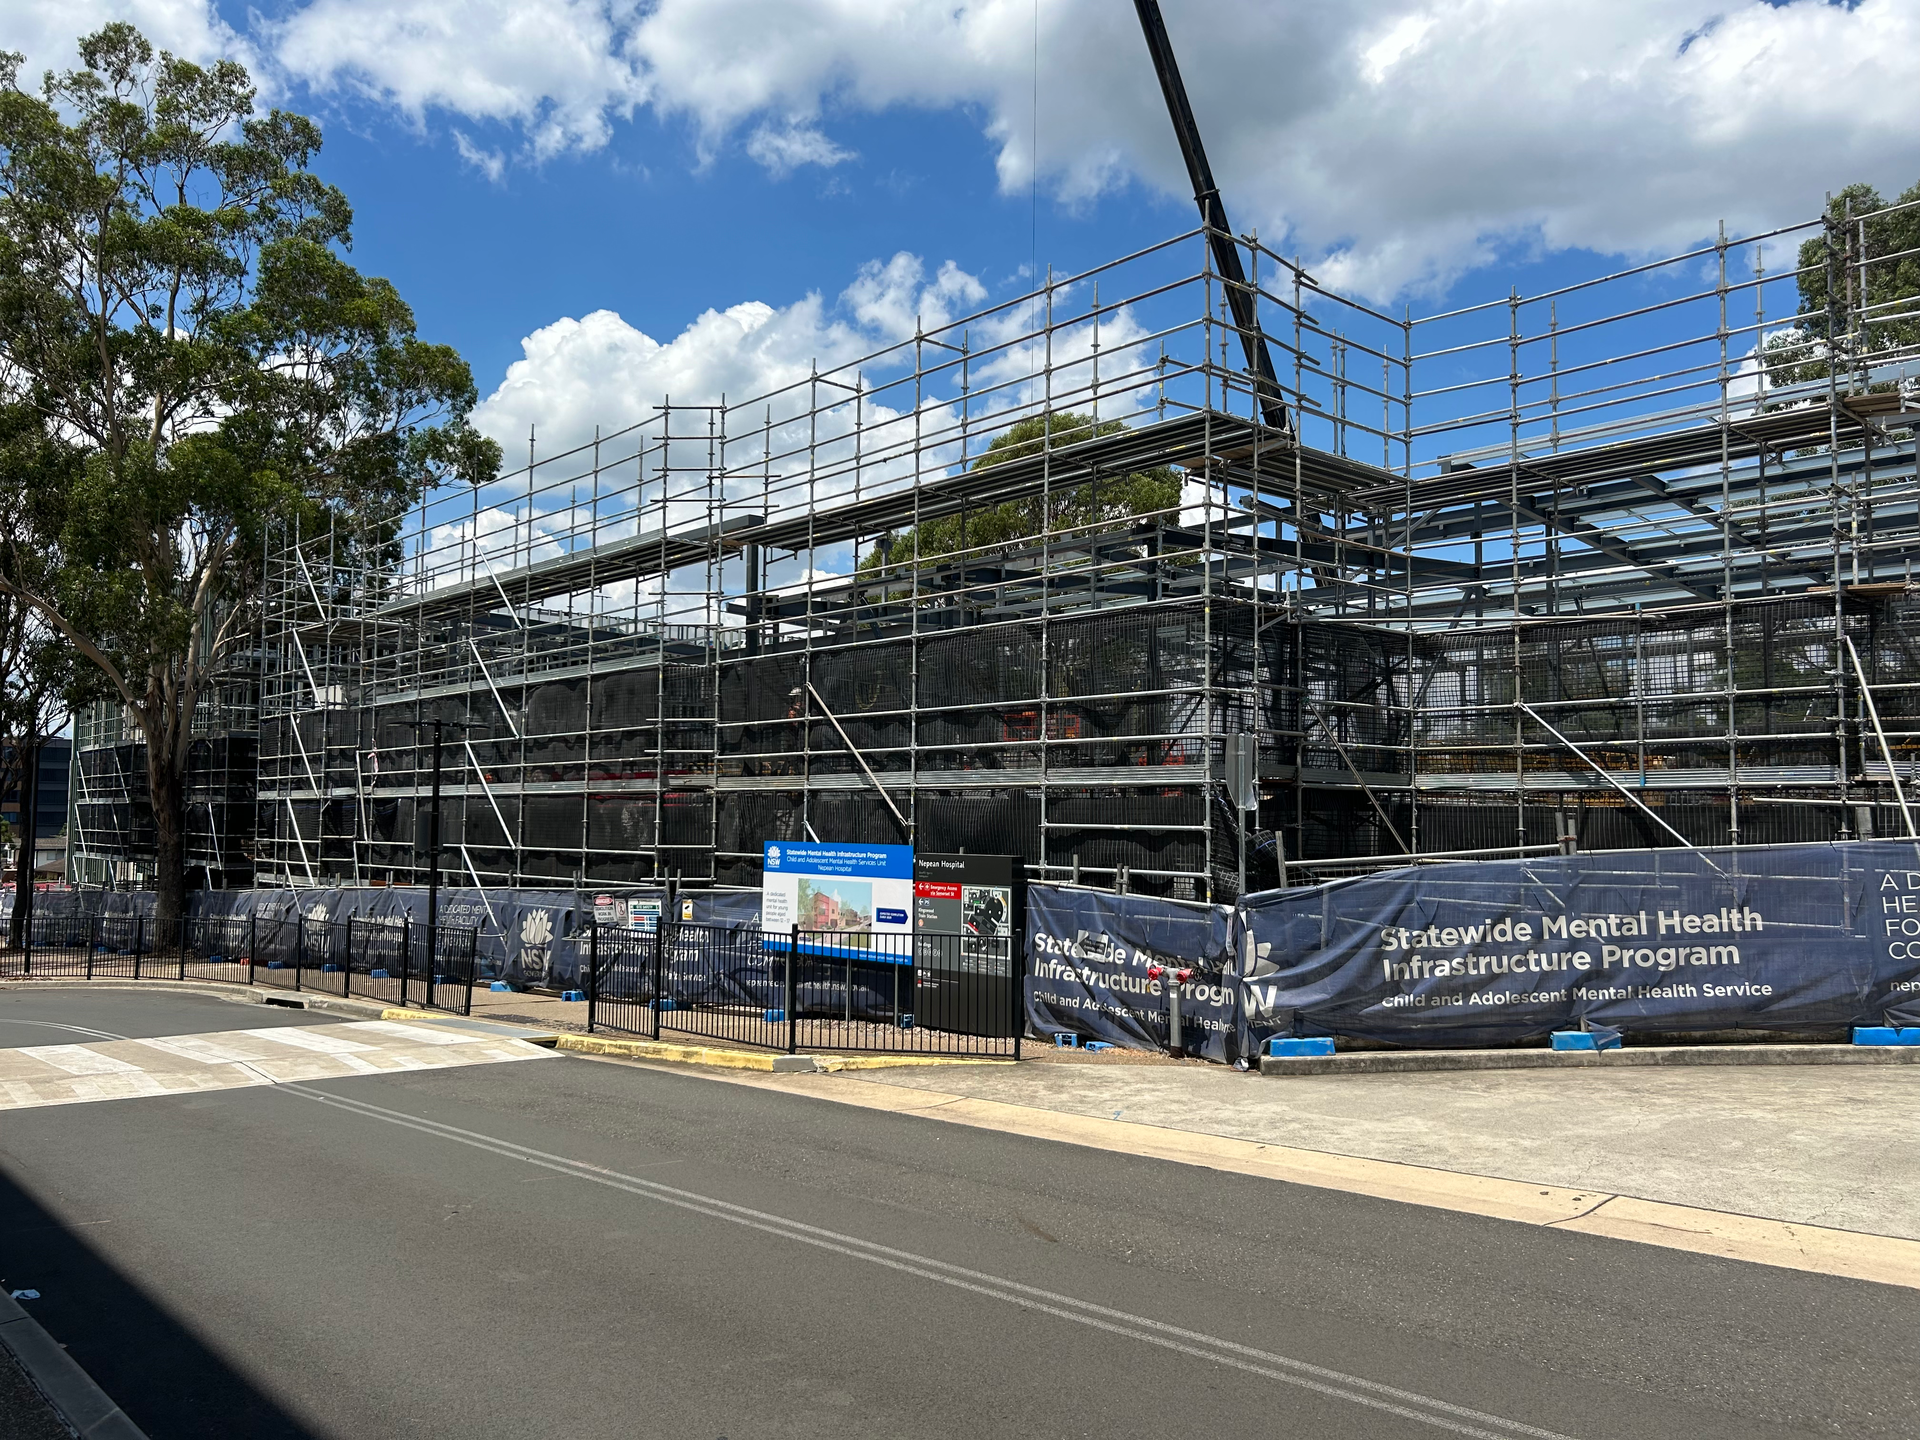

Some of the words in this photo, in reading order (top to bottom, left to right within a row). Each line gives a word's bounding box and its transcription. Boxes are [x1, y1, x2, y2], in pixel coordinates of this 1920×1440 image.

[767, 858, 781, 866] NSW
[867, 852, 887, 860] Program
[918, 859, 940, 869] Nepean
[941, 860, 965, 870] Hospital
[818, 864, 834, 872] Nepean
[834, 865, 852, 873] Hospital
[1880, 873, 1899, 891] A
[1380, 917, 1533, 951] Statewide
[1541, 910, 1648, 941] Mental
[1657, 906, 1764, 935] Health
[1034, 931, 1126, 966] Statede
[1382, 949, 1592, 982] Infrastructure
[1601, 944, 1741, 972] Program
[1381, 993, 1426, 1008] Child
[1430, 992, 1463, 1007] and
[1468, 989, 1567, 1007] Adolescent
[1572, 985, 1632, 1001] Mental
[1637, 983, 1698, 999] Health
[1702, 981, 1773, 997] Service
[1033, 990, 1057, 1005] Child
[1059, 995, 1080, 1010] and
[1147, 1011, 1189, 1028] Menal
